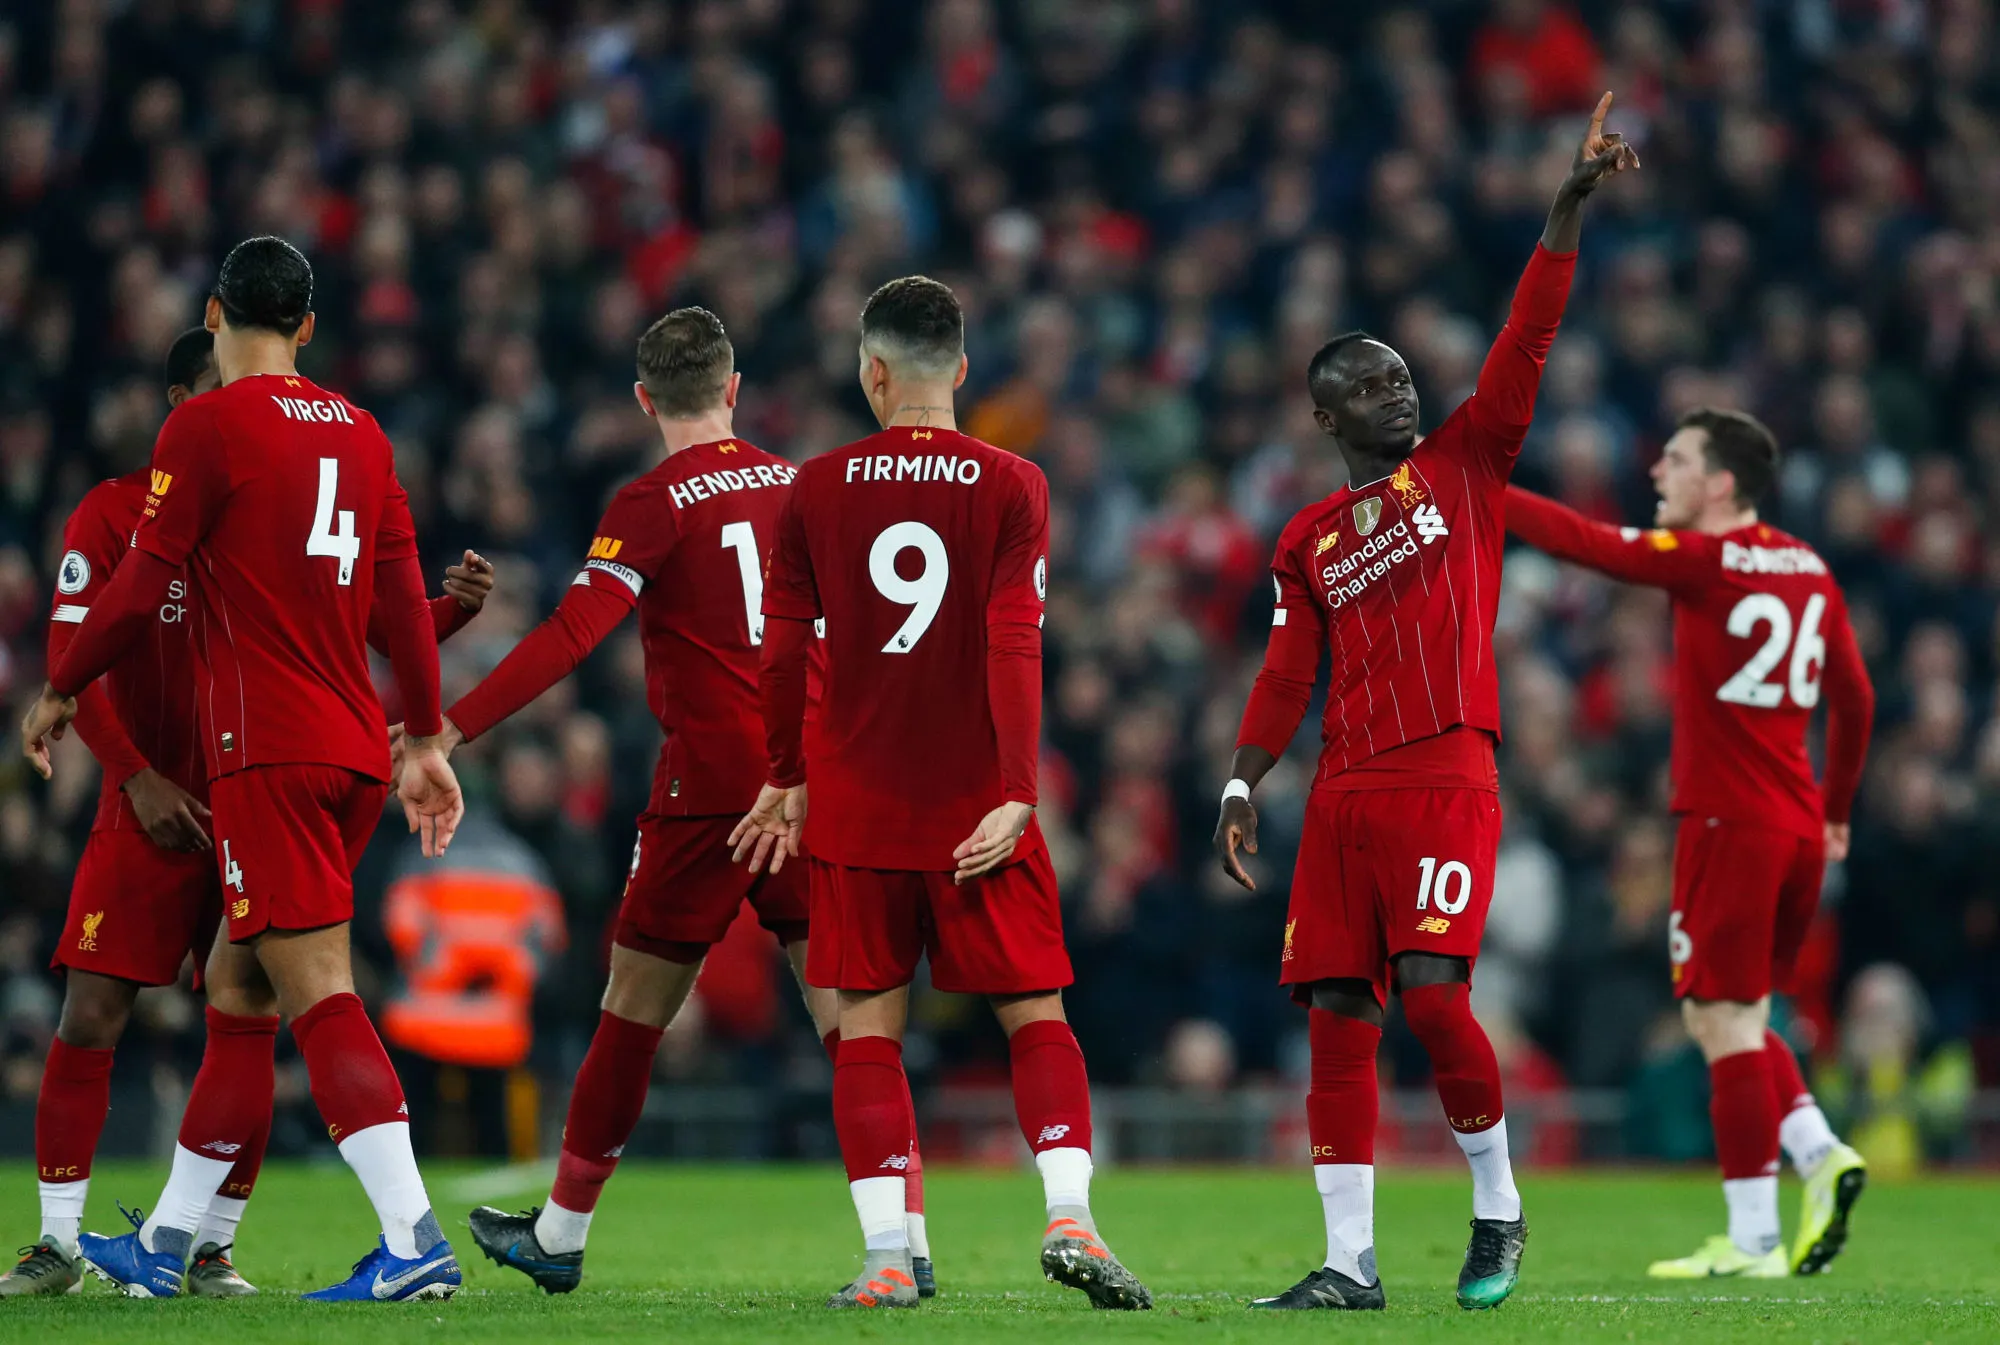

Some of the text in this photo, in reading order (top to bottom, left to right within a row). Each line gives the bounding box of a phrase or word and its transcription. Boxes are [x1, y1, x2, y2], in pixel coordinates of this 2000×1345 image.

[270, 395, 355, 425] VIRGIL
[845, 454, 982, 485] FIRMINO
[305, 456, 361, 587] 4
[1322, 518, 1409, 586] Standard
[168, 580, 187, 599] S
[590, 559, 634, 582] aptain
[720, 520, 765, 647] 1
[868, 520, 950, 654] 9
[1326, 536, 1420, 609] Chartered
[1716, 592, 1827, 710] 26
[222, 839, 245, 894] 4
[1415, 856, 1473, 915] 10
